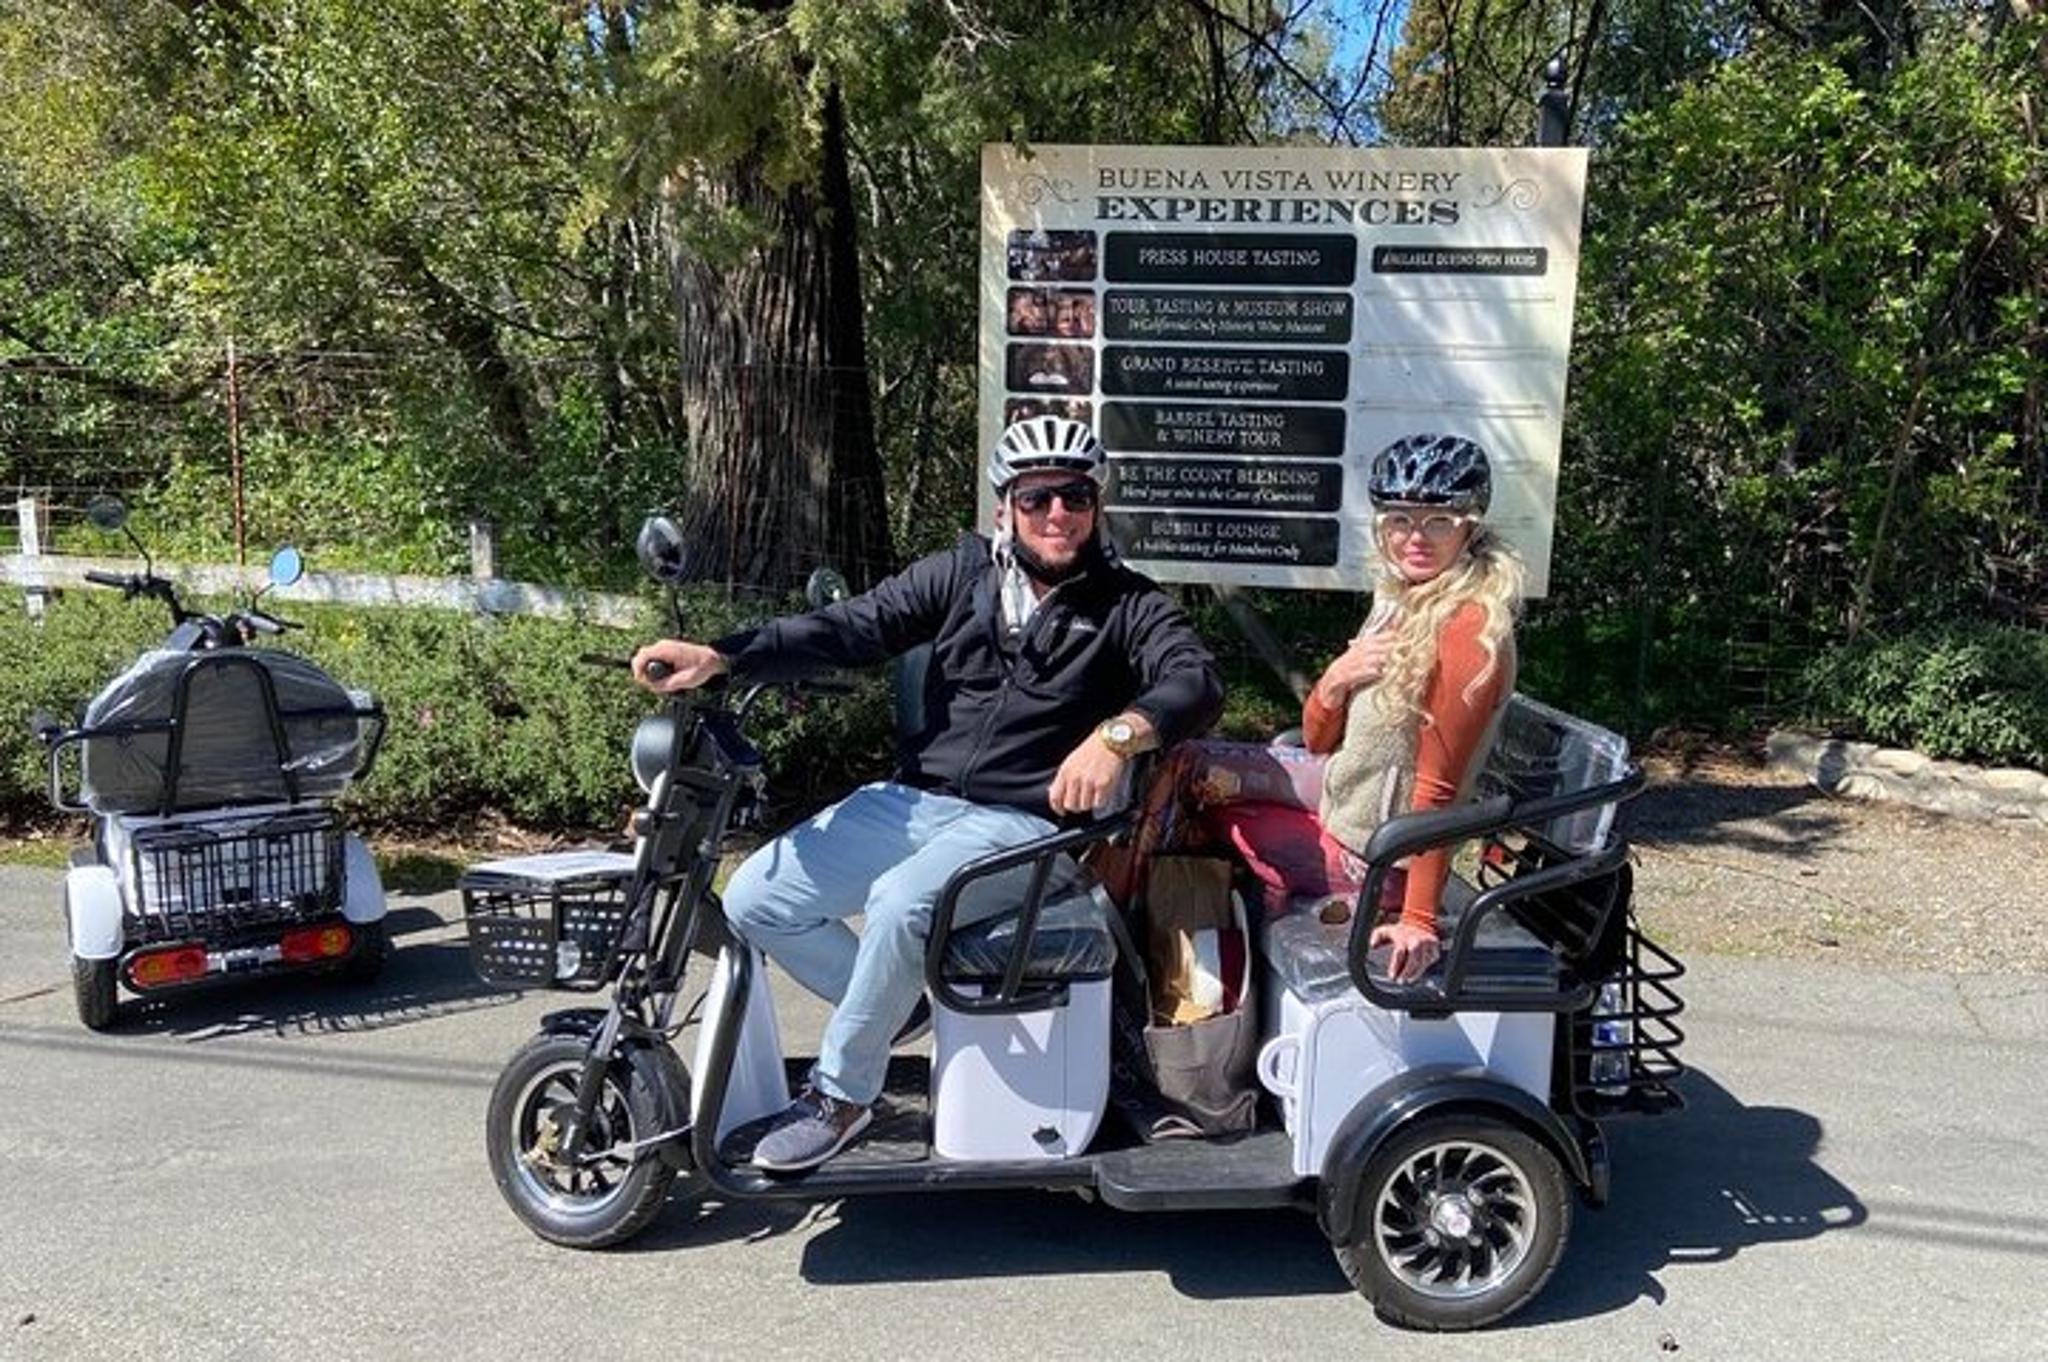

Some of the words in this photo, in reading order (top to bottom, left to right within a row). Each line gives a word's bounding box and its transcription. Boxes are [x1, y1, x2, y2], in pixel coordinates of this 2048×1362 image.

[1099, 167, 1209, 190] BUENA
[1222, 169, 1313, 191] VISTA
[1325, 171, 1461, 193] WINERY
[1095, 196, 1461, 225] EXPERIENCES
[1139, 249, 1188, 265] PRESS
[1193, 249, 1247, 266] HOUSE
[1252, 250, 1320, 267] TASTING
[1154, 298, 1213, 315] TASTING
[1216, 300, 1230, 316] &
[1233, 300, 1299, 317] MUSEUM
[1301, 302, 1347, 317] SHOW
[1121, 355, 1176, 374] GRAND
[1181, 357, 1255, 376] RESERVE
[1259, 358, 1325, 377] TASTING
[1155, 410, 1216, 427] BARREL
[1220, 412, 1286, 429] TASTING
[1156, 431, 1169, 444] &
[1173, 430, 1236, 445] WINERY
[1239, 431, 1282, 447] TOUR
[1118, 466, 1140, 482] BE
[1144, 466, 1177, 483] THE
[1179, 467, 1233, 485] COUNT
[1236, 469, 1320, 486] BLENDING
[1152, 520, 1213, 538] BUBBLE
[1216, 523, 1281, 539] LOUNGE
